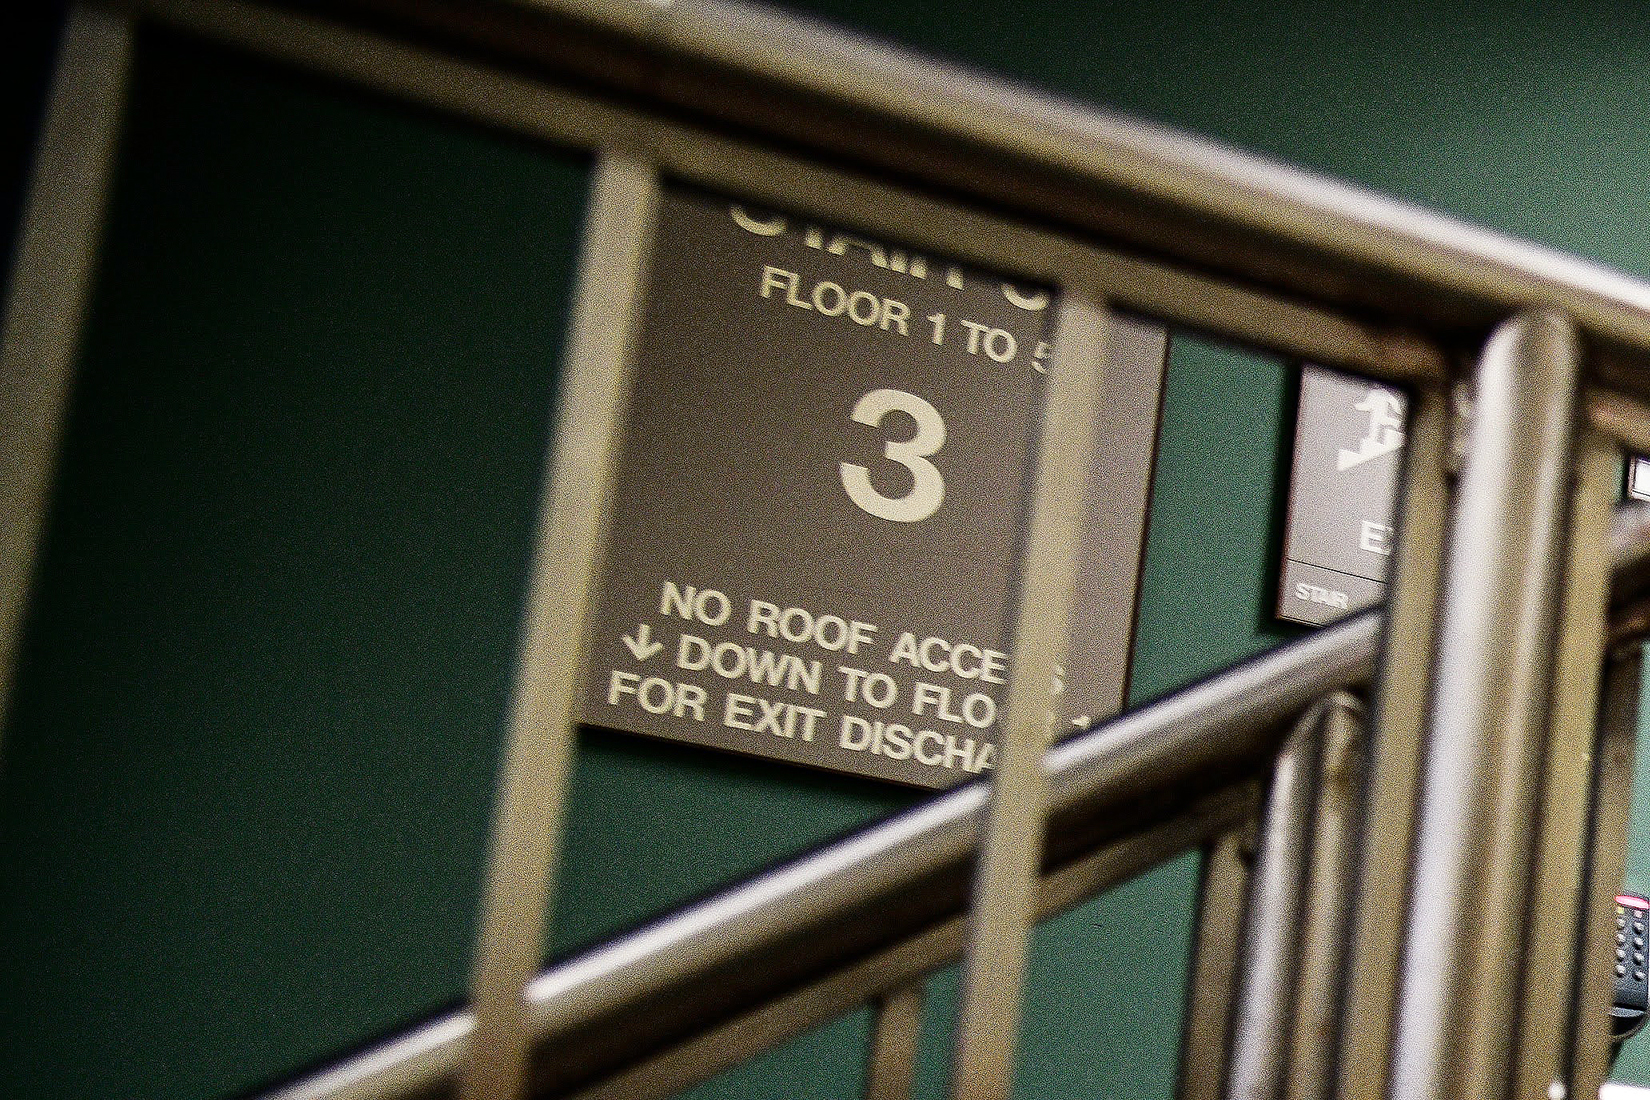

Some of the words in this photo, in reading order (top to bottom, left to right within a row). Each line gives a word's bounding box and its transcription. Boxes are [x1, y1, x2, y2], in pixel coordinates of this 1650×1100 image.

[760, 265, 911, 336] FLOOR
[926, 313, 946, 345] 1
[961, 320, 1017, 363] TO
[840, 389, 947, 523] 3
[660, 581, 732, 627] NO
[747, 599, 878, 655] ROOF
[890, 632, 1065, 694] ACCE
[677, 634, 823, 695] DOWN
[838, 666, 898, 709] TO
[913, 681, 998, 729] FLO
[608, 670, 708, 722] FOR
[724, 693, 828, 742] EXIT
[840, 715, 996, 774] DISCHA
